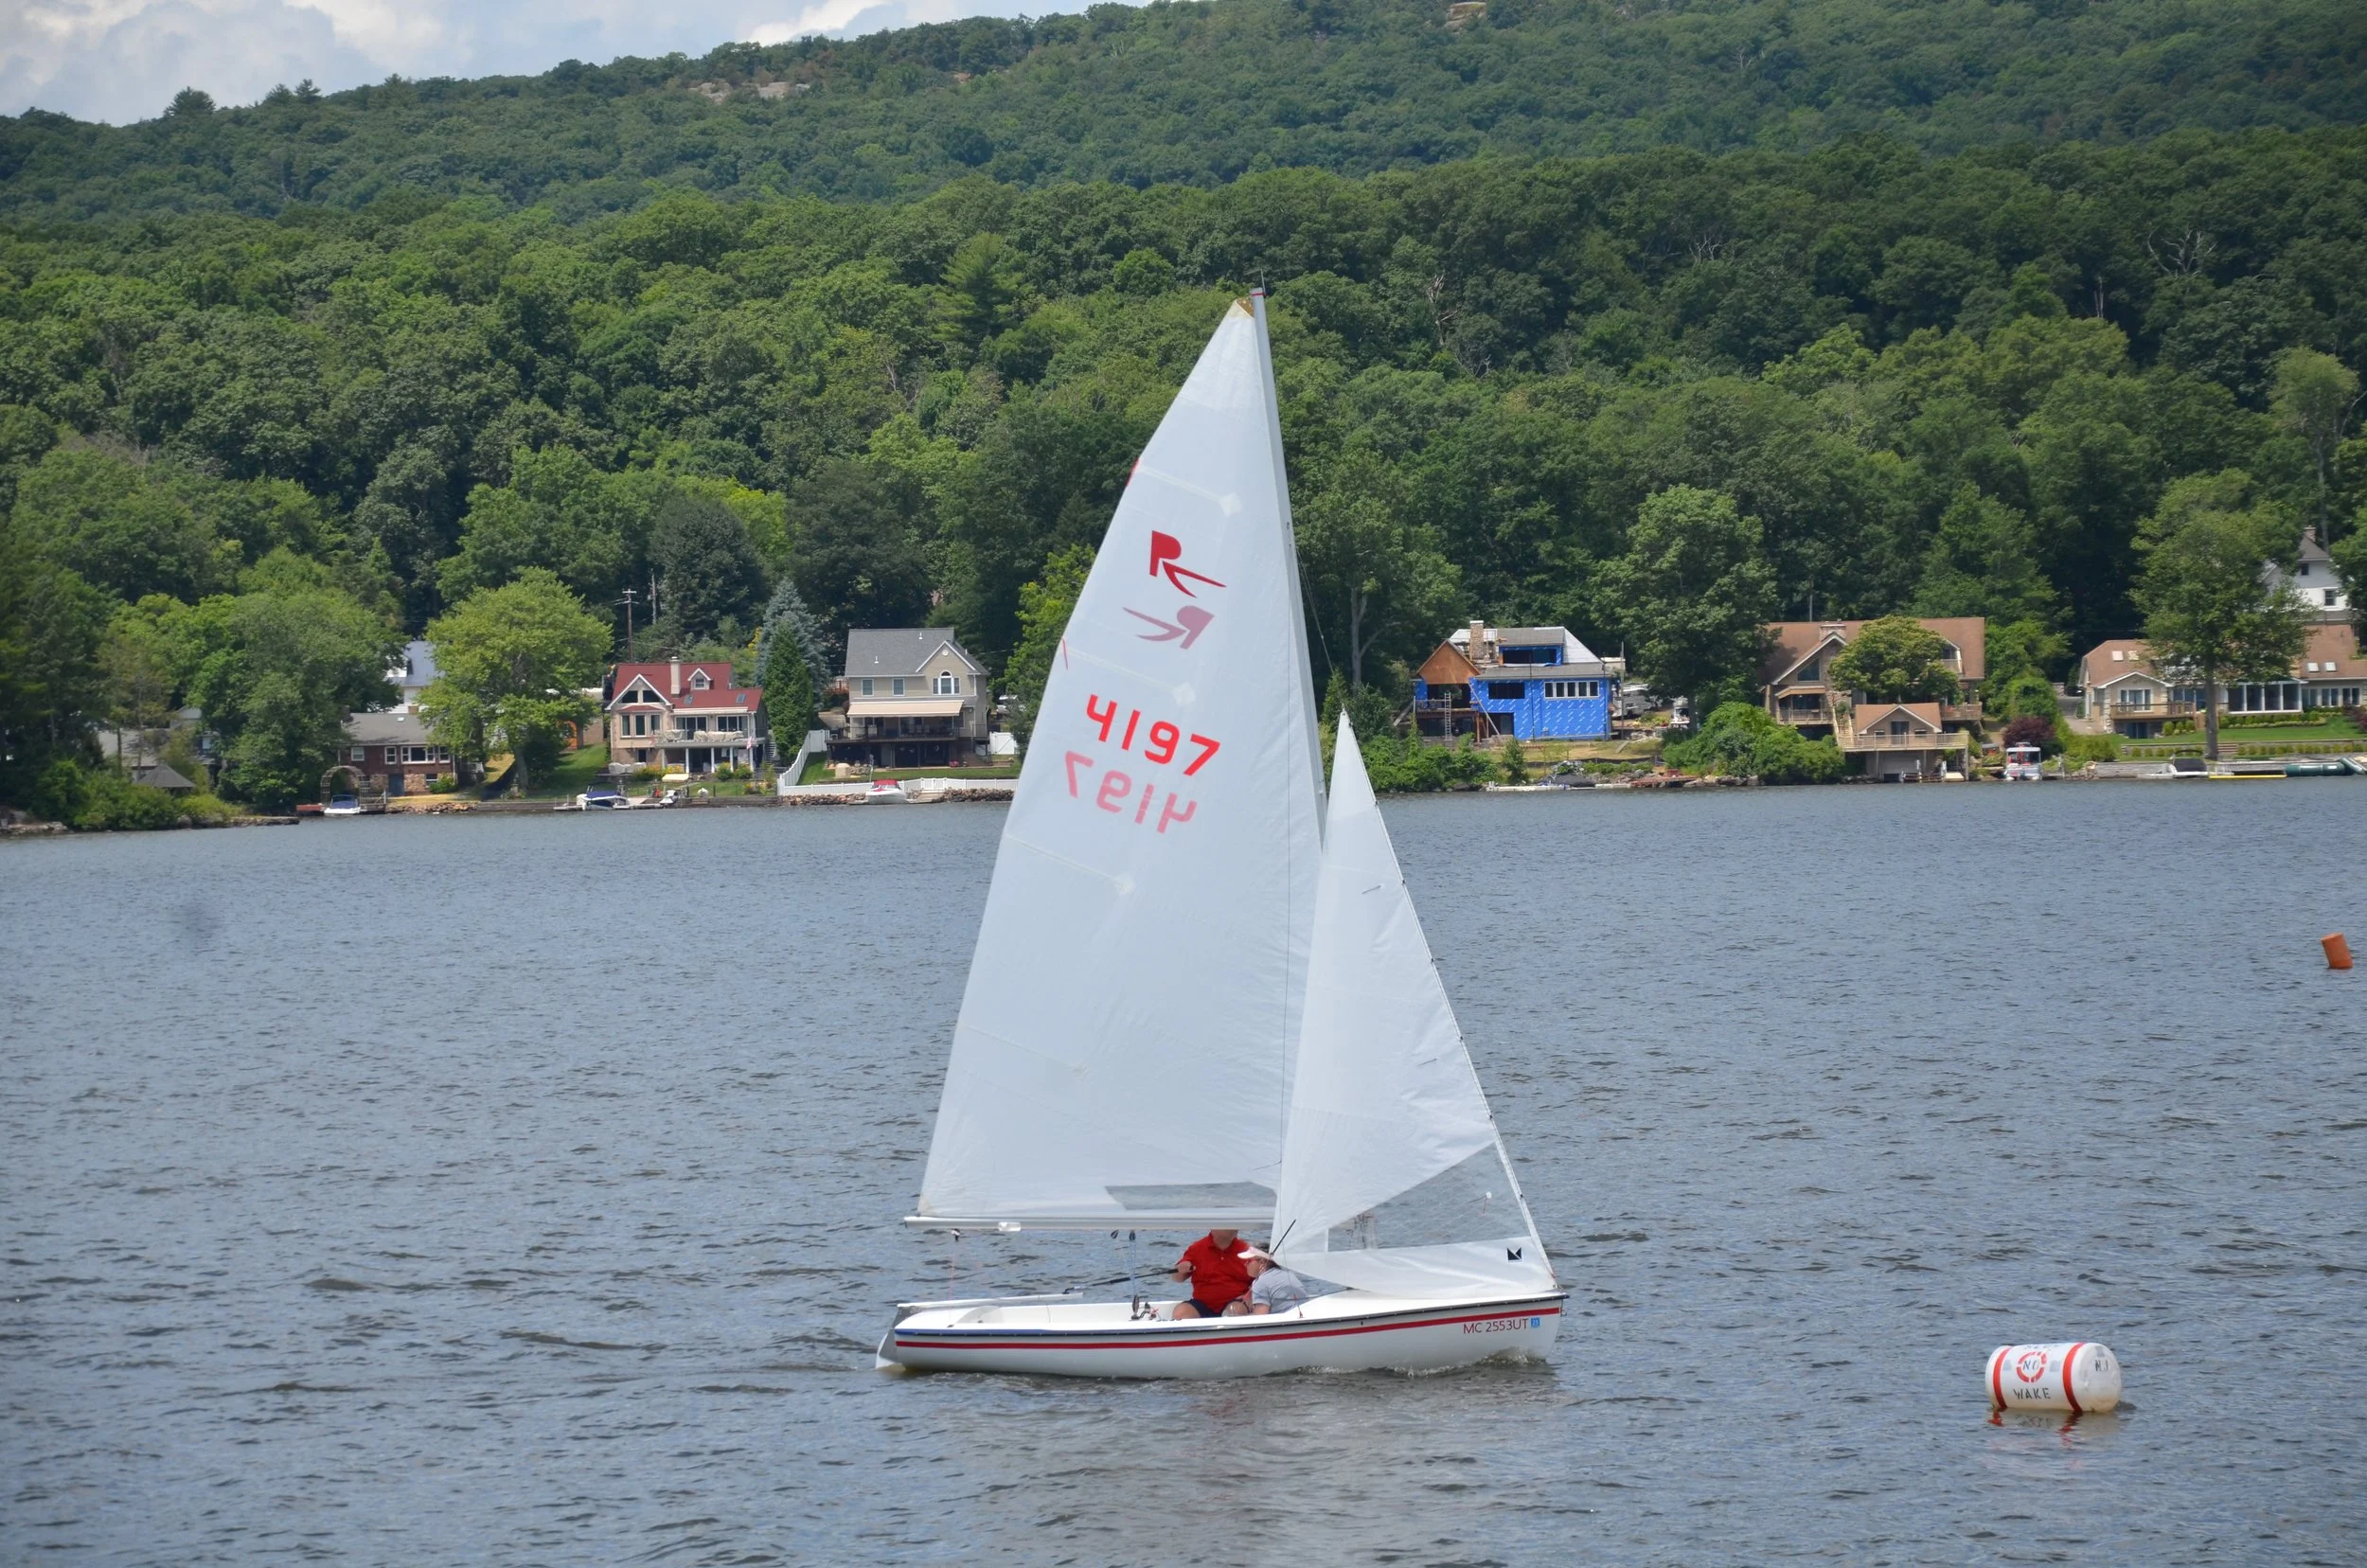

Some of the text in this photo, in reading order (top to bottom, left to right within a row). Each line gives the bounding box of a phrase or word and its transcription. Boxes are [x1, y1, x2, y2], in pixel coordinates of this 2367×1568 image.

[1086, 694, 1221, 777] 4197
[1463, 1318, 1528, 1334] MC 2553UT
[2013, 1387, 2051, 1399] WAKE
